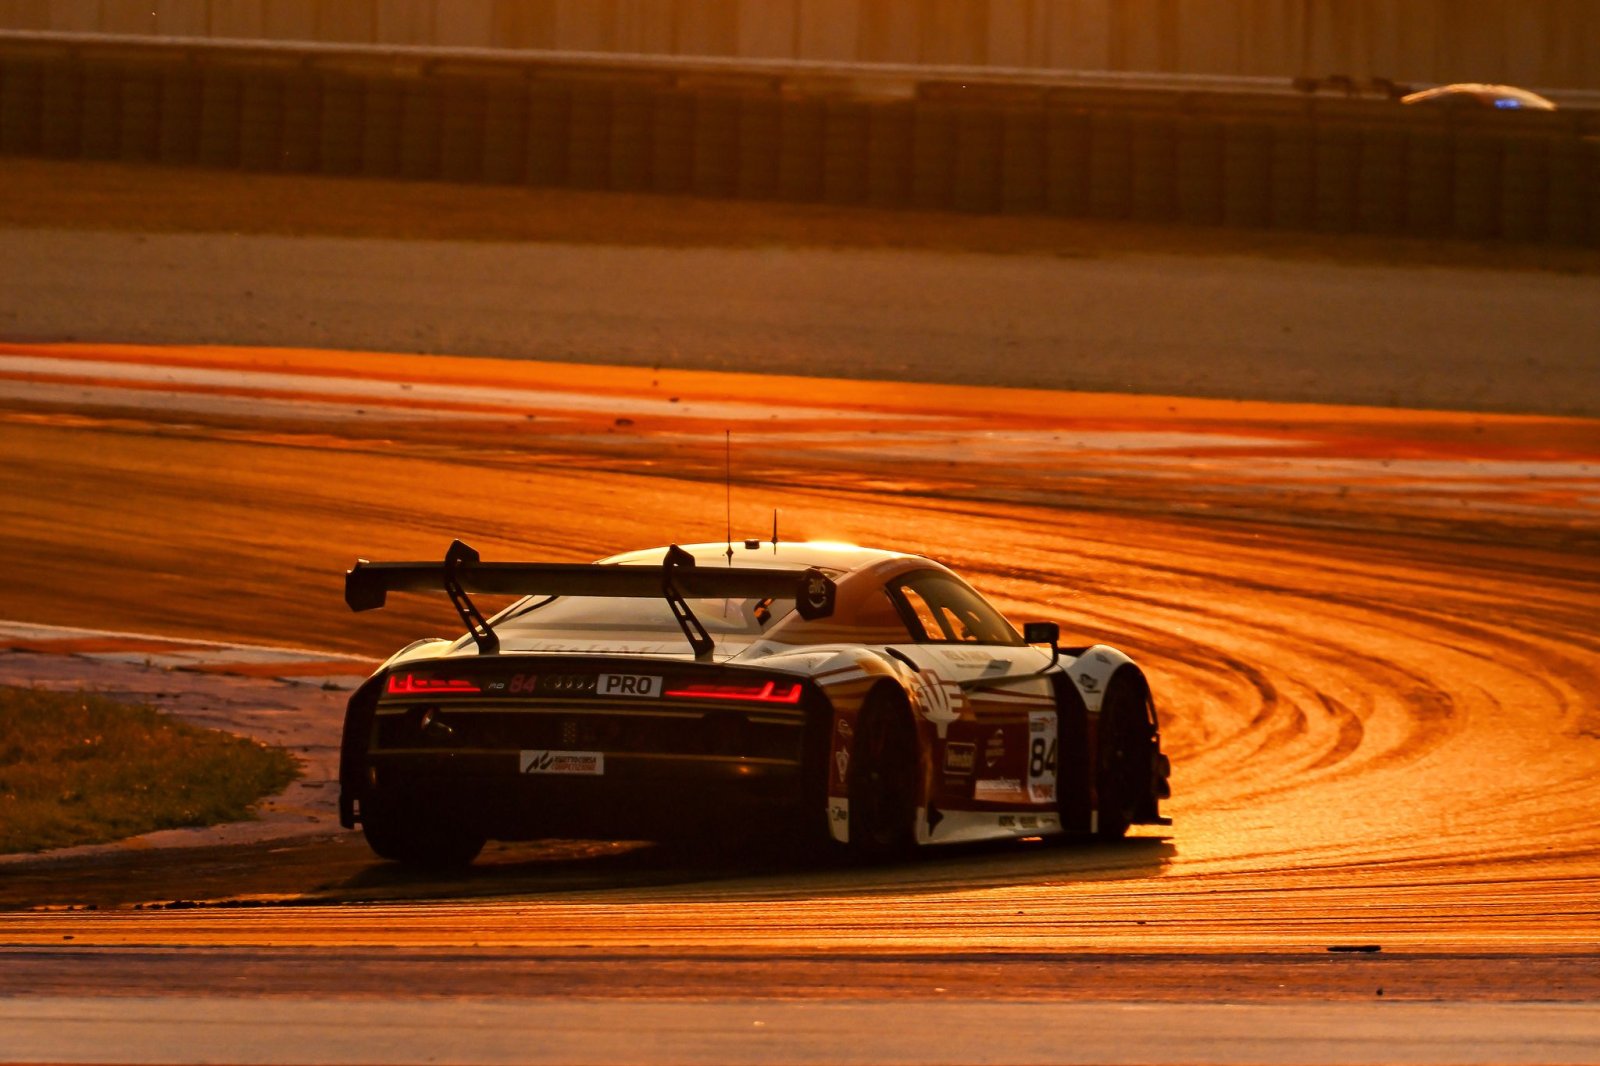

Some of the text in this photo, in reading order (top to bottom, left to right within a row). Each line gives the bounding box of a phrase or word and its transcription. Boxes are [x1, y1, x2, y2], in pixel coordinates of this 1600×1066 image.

[509, 674, 537, 694] 84
[606, 675, 652, 694] PRO
[1030, 738, 1056, 778] 84
